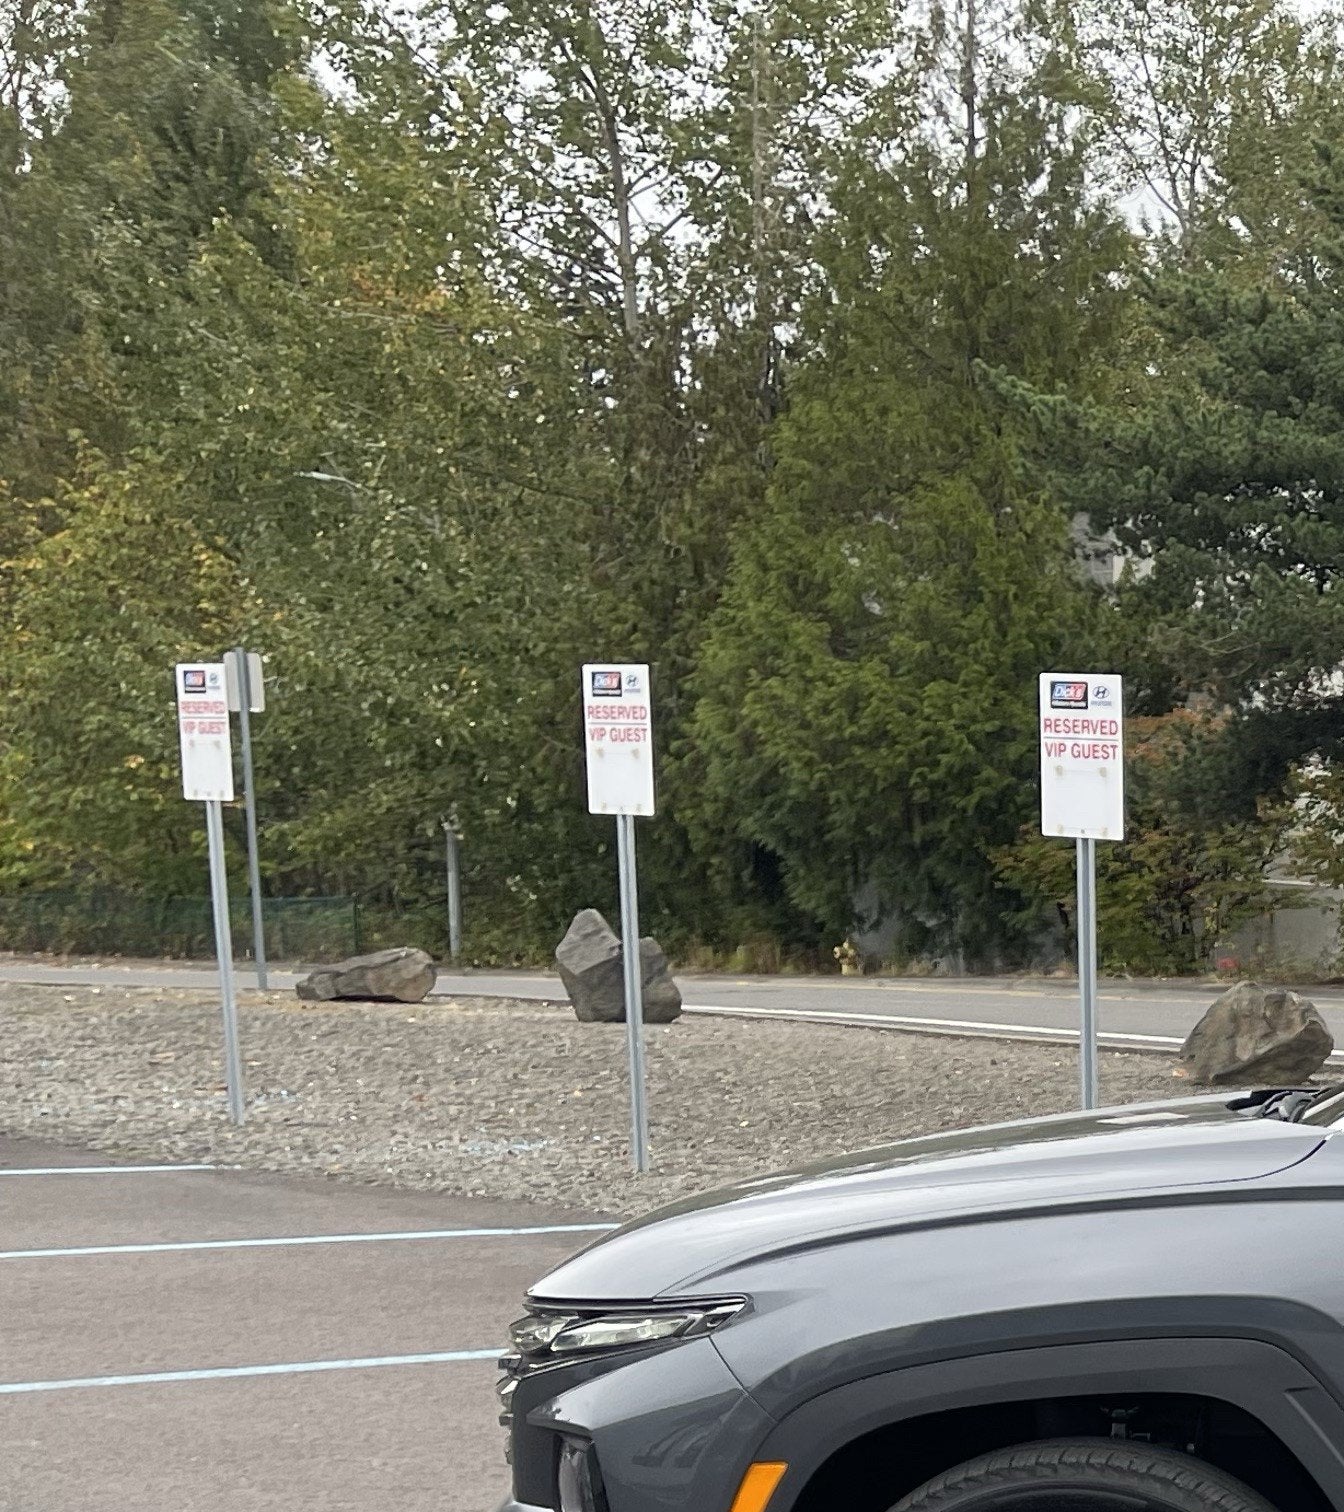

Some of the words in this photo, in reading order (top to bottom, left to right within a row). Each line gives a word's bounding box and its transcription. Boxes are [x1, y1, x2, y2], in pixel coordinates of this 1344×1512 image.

[587, 705, 648, 721] RESERVED
[589, 727, 606, 742] VIP
[609, 728, 648, 743] GUEST
[1043, 718, 1119, 736] RESERVED
[1044, 742, 1067, 758] VIP
[1071, 743, 1119, 760] GUEST
